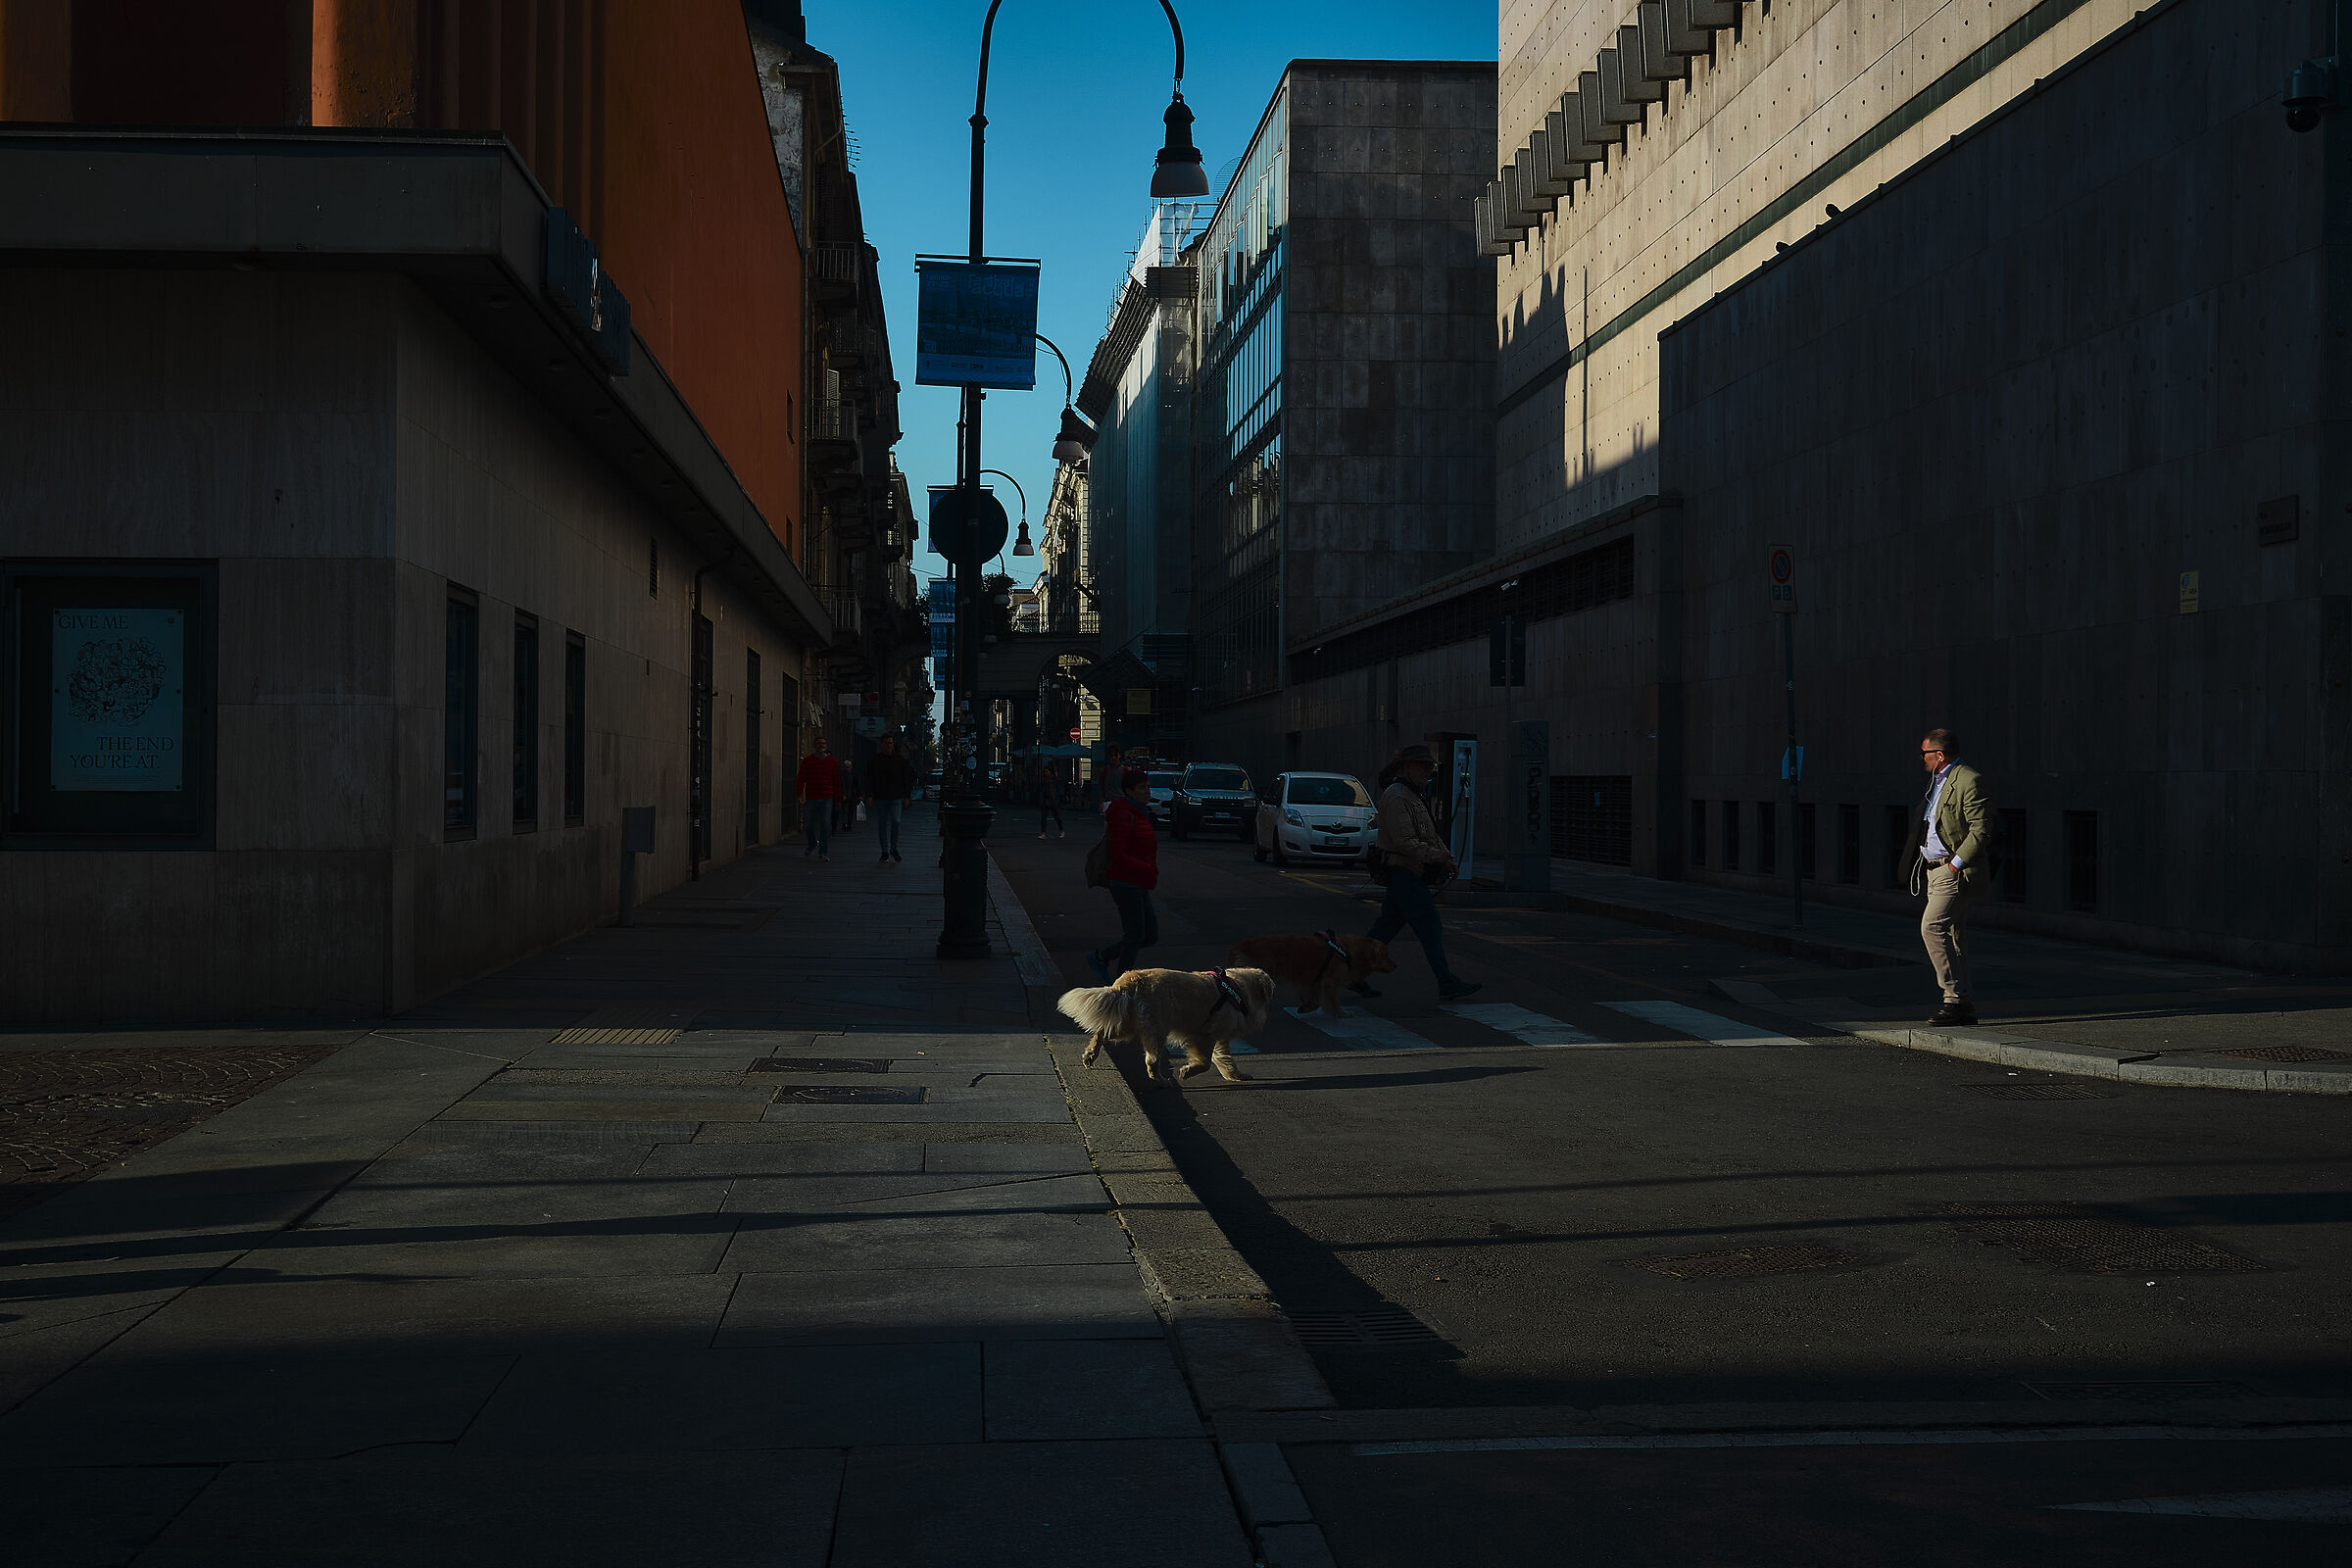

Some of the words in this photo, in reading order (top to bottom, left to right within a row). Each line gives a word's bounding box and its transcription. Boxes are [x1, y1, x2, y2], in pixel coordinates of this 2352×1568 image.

[58, 614, 99, 629] GIVE
[103, 614, 128, 629] ME
[96, 736, 132, 751] THE
[136, 736, 174, 751] END
